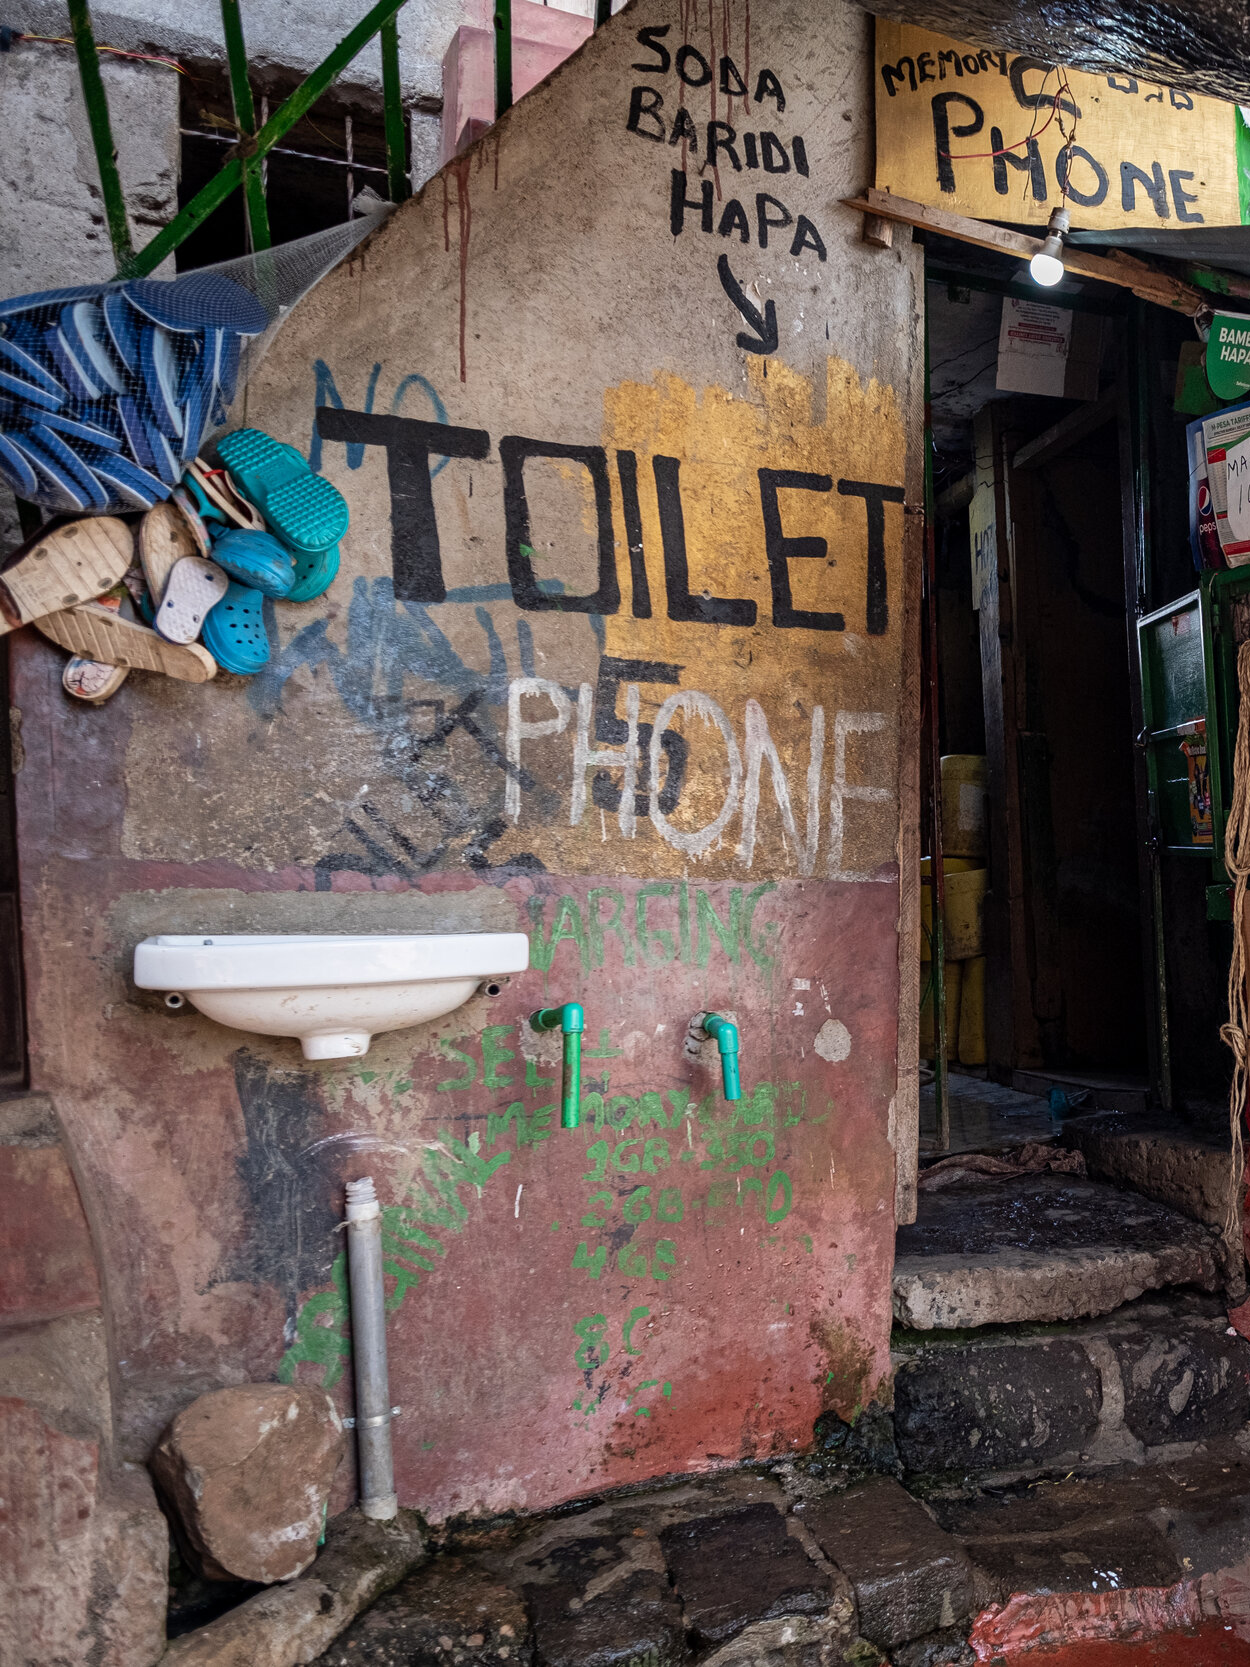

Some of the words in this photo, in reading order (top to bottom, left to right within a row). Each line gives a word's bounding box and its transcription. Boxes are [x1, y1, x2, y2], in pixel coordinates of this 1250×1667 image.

[631, 24, 786, 112] SODA
[881, 50, 1010, 96] MEMORY
[626, 85, 809, 178] BARIDI
[931, 91, 1204, 223] PHONE
[670, 168, 827, 262] HAPA
[308, 358, 450, 480] NO
[316, 406, 905, 635] TOILET
[1199, 520, 1217, 534] peps
[506, 677, 894, 881] PHONE
